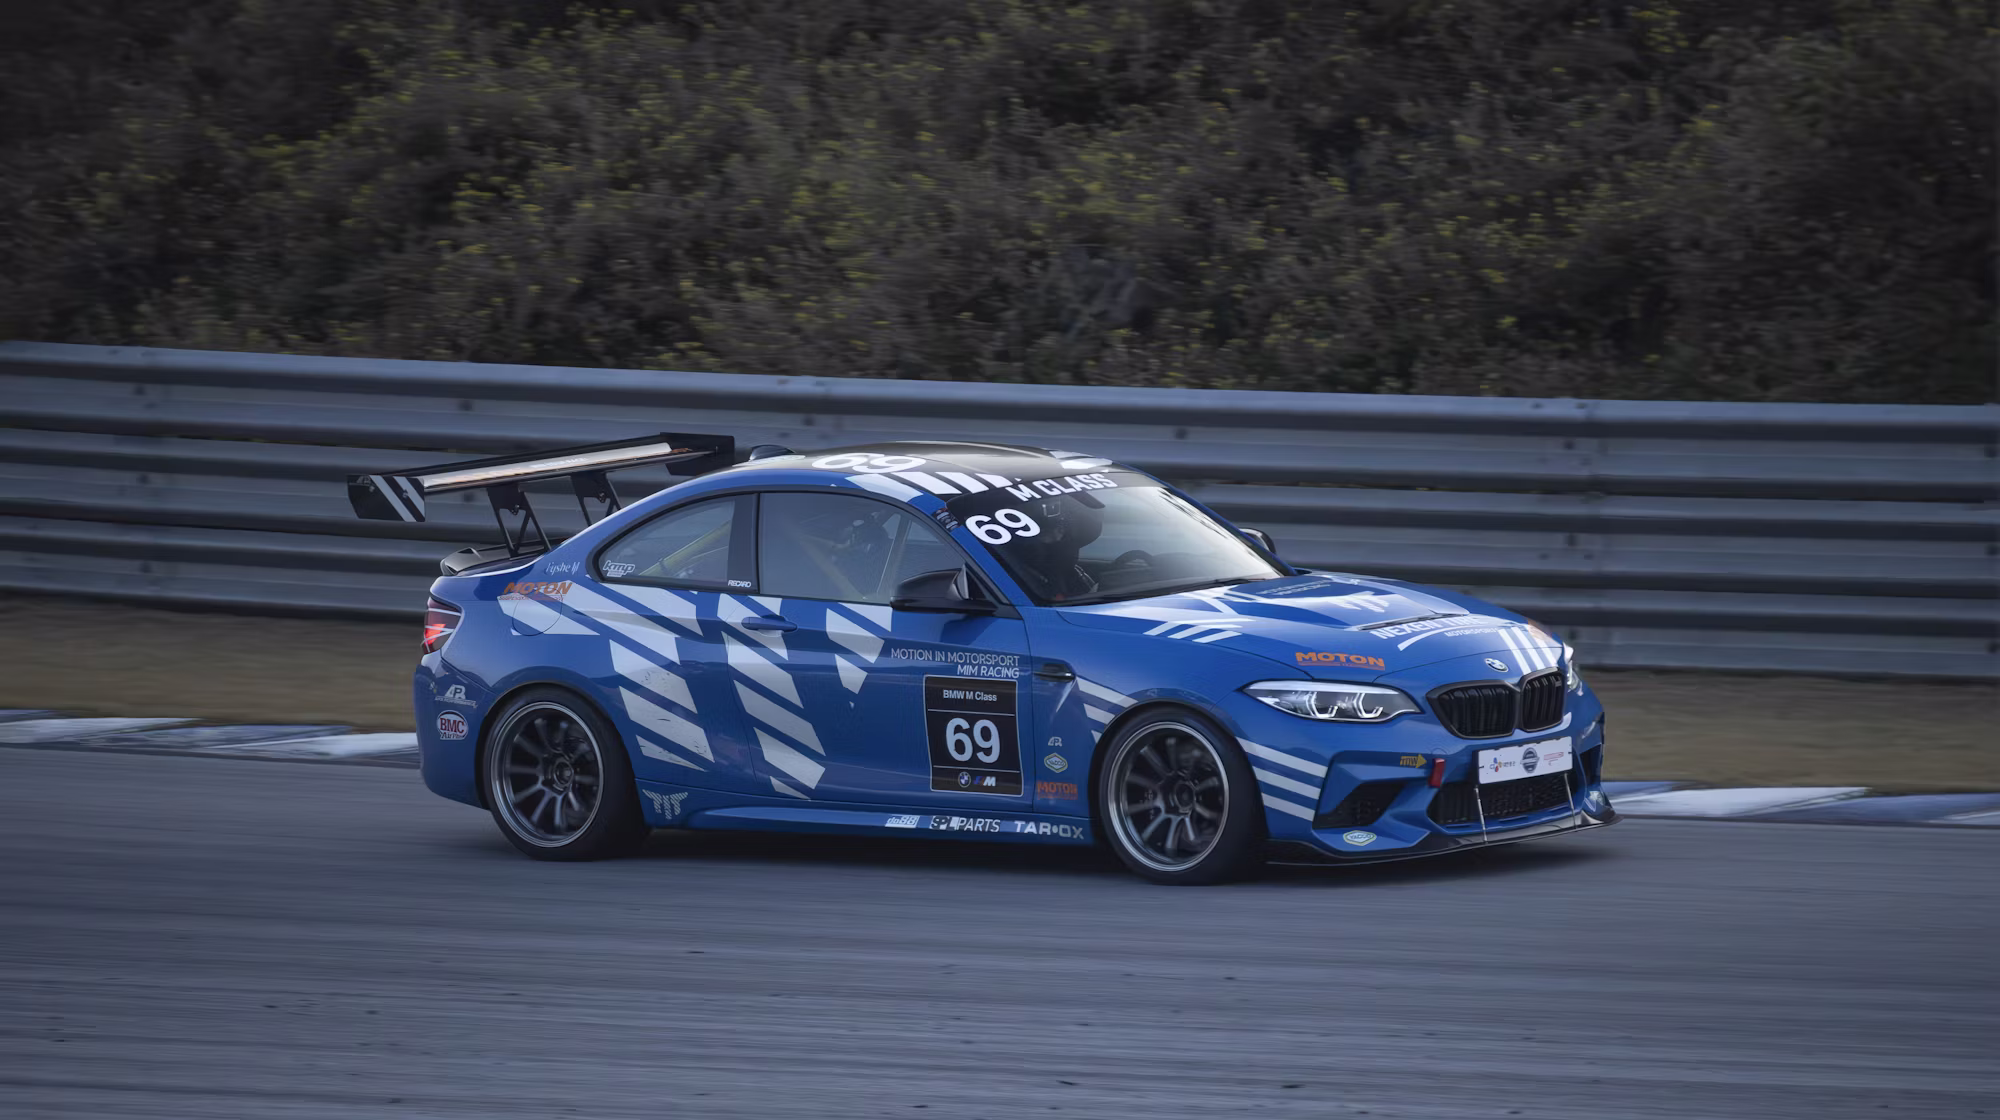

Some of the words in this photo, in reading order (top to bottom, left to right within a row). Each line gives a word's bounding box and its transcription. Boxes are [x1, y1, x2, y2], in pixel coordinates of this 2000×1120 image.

[811, 452, 927, 474] 69
[1005, 483, 1042, 502] M
[1032, 473, 1119, 496] CLASS
[965, 508, 1041, 545] 69
[502, 581, 573, 595] MOTON
[1369, 619, 1440, 640] NEXEN
[891, 648, 933, 661] MOTION
[935, 651, 946, 662] IN
[948, 652, 1020, 667] MOTORSPORT
[1294, 651, 1385, 667] MOTON
[957, 664, 978, 677] MIM
[980, 665, 1020, 679] RACING
[943, 689, 965, 700] BMW
[965, 691, 974, 700] M
[975, 691, 998, 702] Class
[439, 717, 465, 734] BMC
[945, 717, 1001, 764] 69
